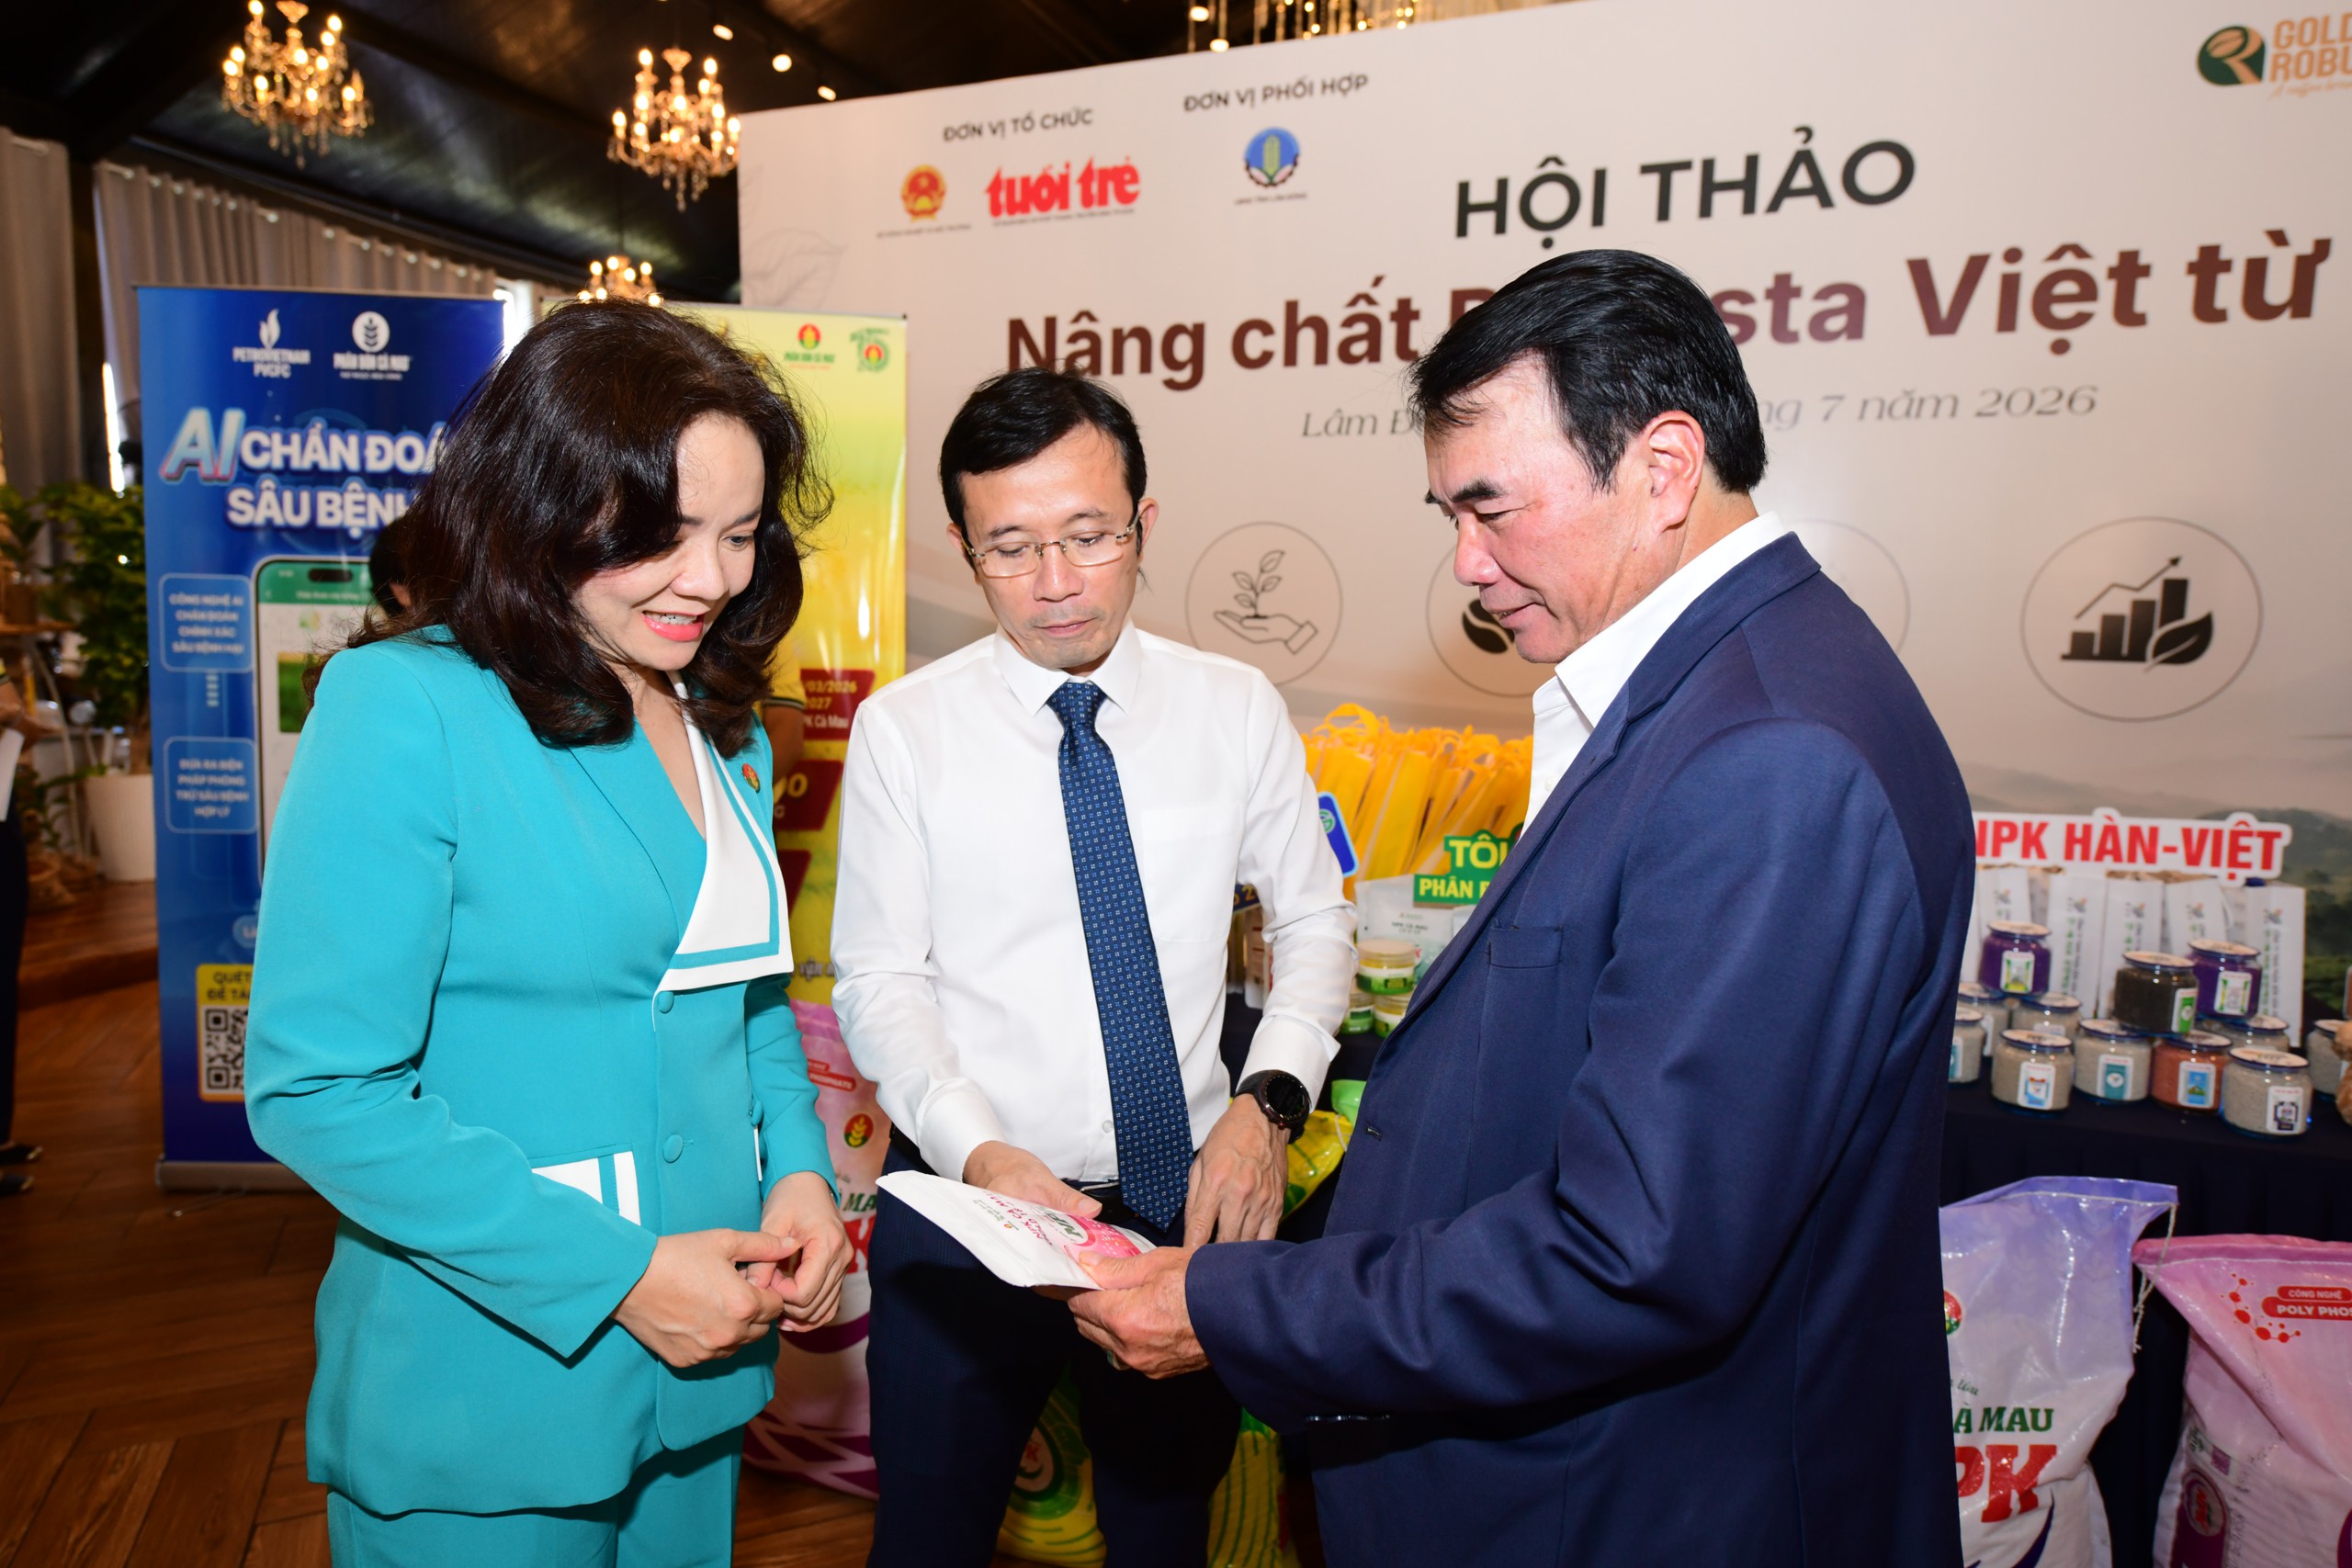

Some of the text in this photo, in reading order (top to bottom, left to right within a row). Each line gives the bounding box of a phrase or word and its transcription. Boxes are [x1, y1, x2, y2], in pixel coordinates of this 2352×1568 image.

[1183, 73, 1369, 112] ĐƠN VỊ PHỐI HỢP
[943, 124, 982, 142] ĐƠN
[987, 121, 1006, 141] VỊ
[1040, 107, 1094, 131] CHỨC
[1455, 126, 1917, 250] HỘI THẢO
[1007, 309, 1206, 392] Nâng
[1231, 275, 1420, 369] chất
[1906, 243, 2154, 356] Việt
[2186, 229, 2335, 324] từ
[1302, 407, 1378, 437] Lâm
[1820, 394, 1845, 422] 7
[1858, 389, 1961, 422] năm
[1973, 385, 2098, 418] 2026
[161, 408, 246, 479] AI
[241, 422, 361, 471] CHẨN
[227, 479, 311, 527] SÂU
[1976, 815, 2282, 880] PK HÀN-VIỆT
[1419, 874, 1474, 899] PHÂN
[2277, 1304, 2314, 1315] POLY
[1953, 1401, 2054, 1434] À MAU
